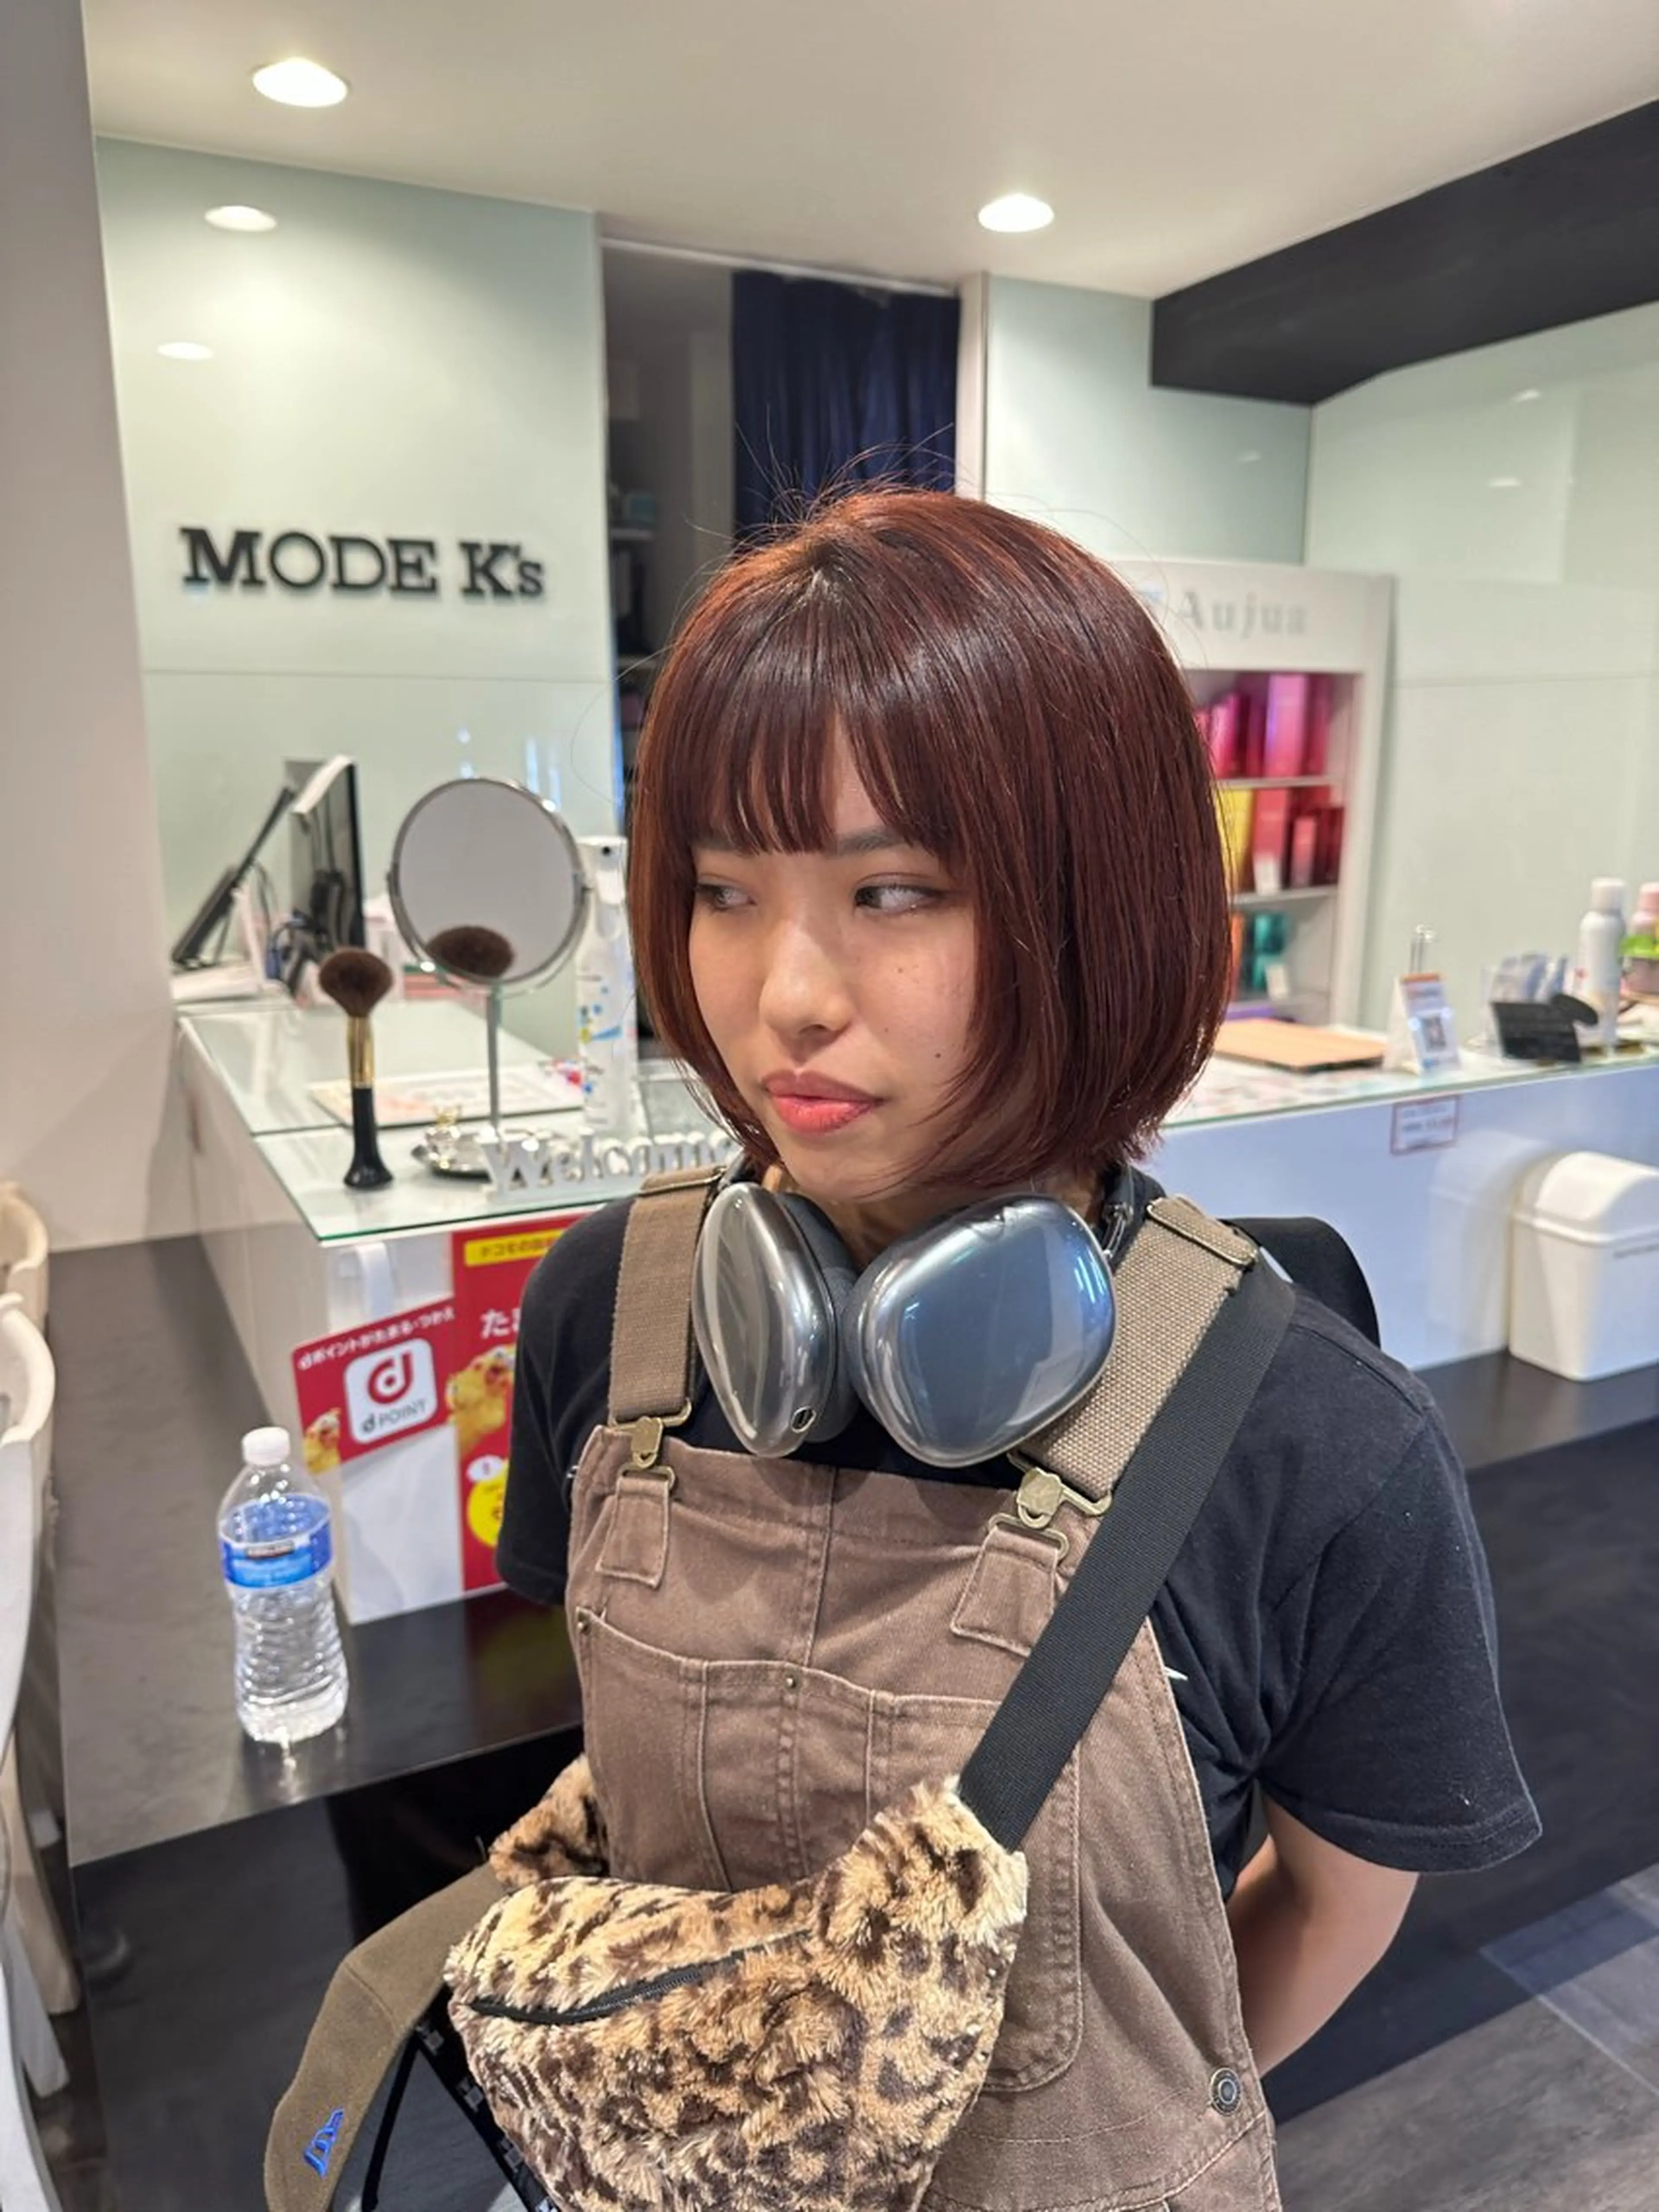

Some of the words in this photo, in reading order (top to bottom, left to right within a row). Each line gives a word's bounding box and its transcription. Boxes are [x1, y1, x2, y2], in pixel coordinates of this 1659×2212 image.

[180, 528, 438, 594] MODE
[460, 541, 544, 597] K's
[360, 1412, 376, 1433] d
[378, 1397, 426, 1427] POINT
